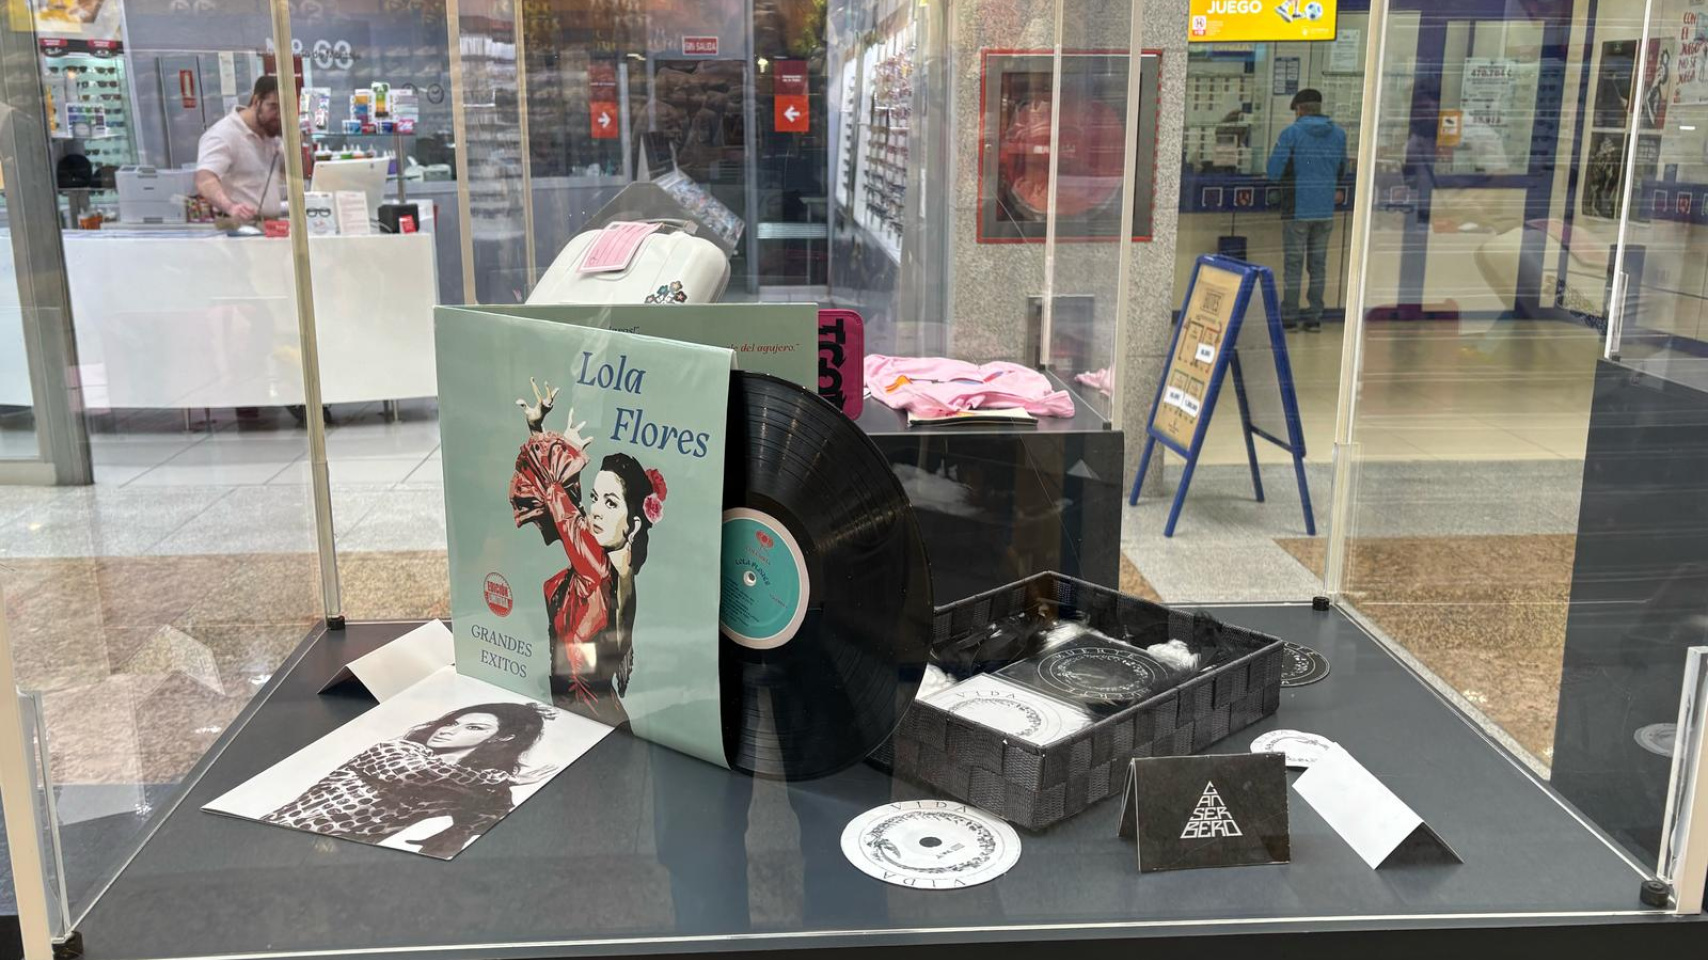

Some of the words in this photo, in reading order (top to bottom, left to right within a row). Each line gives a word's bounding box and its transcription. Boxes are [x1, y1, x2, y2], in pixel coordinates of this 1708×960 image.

[1207, 0, 1262, 14] JUEGO
[577, 351, 647, 394] Lola
[610, 407, 710, 458] Flores
[471, 624, 532, 657] GRANDES
[480, 649, 527, 678] EXITOS
[956, 690, 1016, 699] VIDA
[890, 801, 967, 813] VIDA
[1189, 806, 1233, 821] SER
[1180, 819, 1243, 838] BERO
